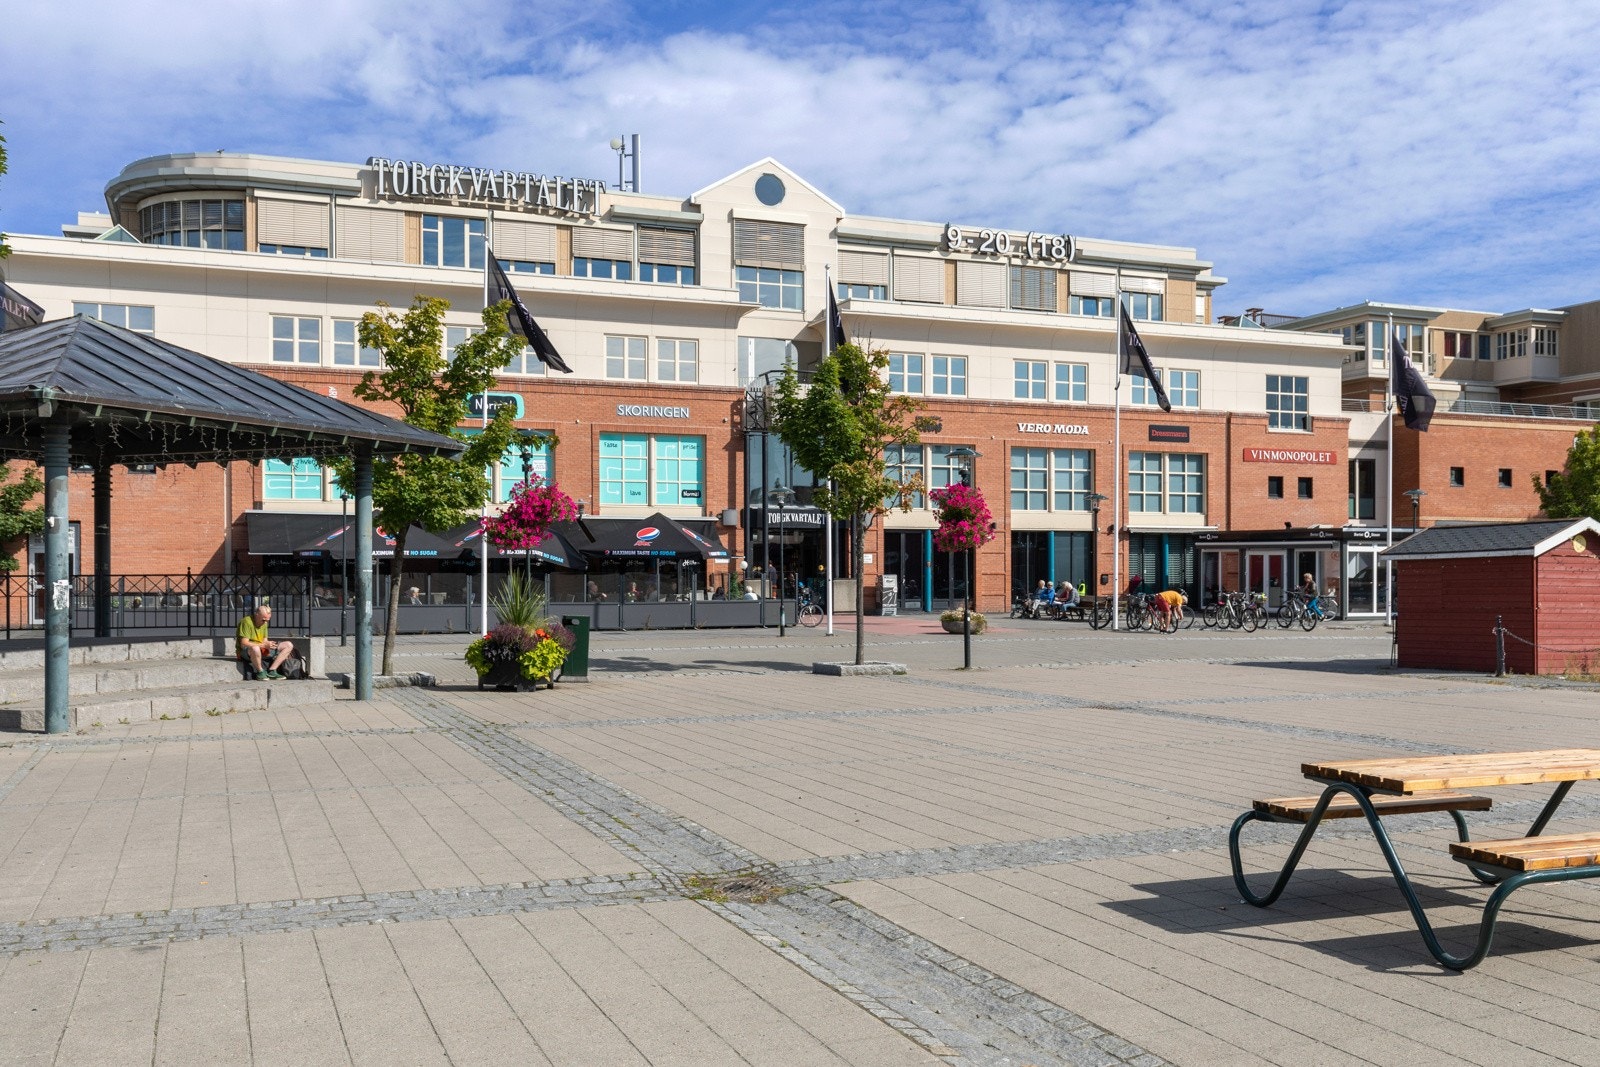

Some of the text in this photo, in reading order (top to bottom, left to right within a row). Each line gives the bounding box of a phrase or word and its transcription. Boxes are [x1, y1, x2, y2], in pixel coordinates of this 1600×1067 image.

[371, 157, 606, 217] TORGKVARTALET
[1027, 231, 1076, 262] (18)
[617, 404, 689, 418] SKORINGEN
[1017, 423, 1089, 435] VERO MODA
[1151, 429, 1188, 438] Dressmann
[1251, 449, 1332, 462] VINMONOPOLET
